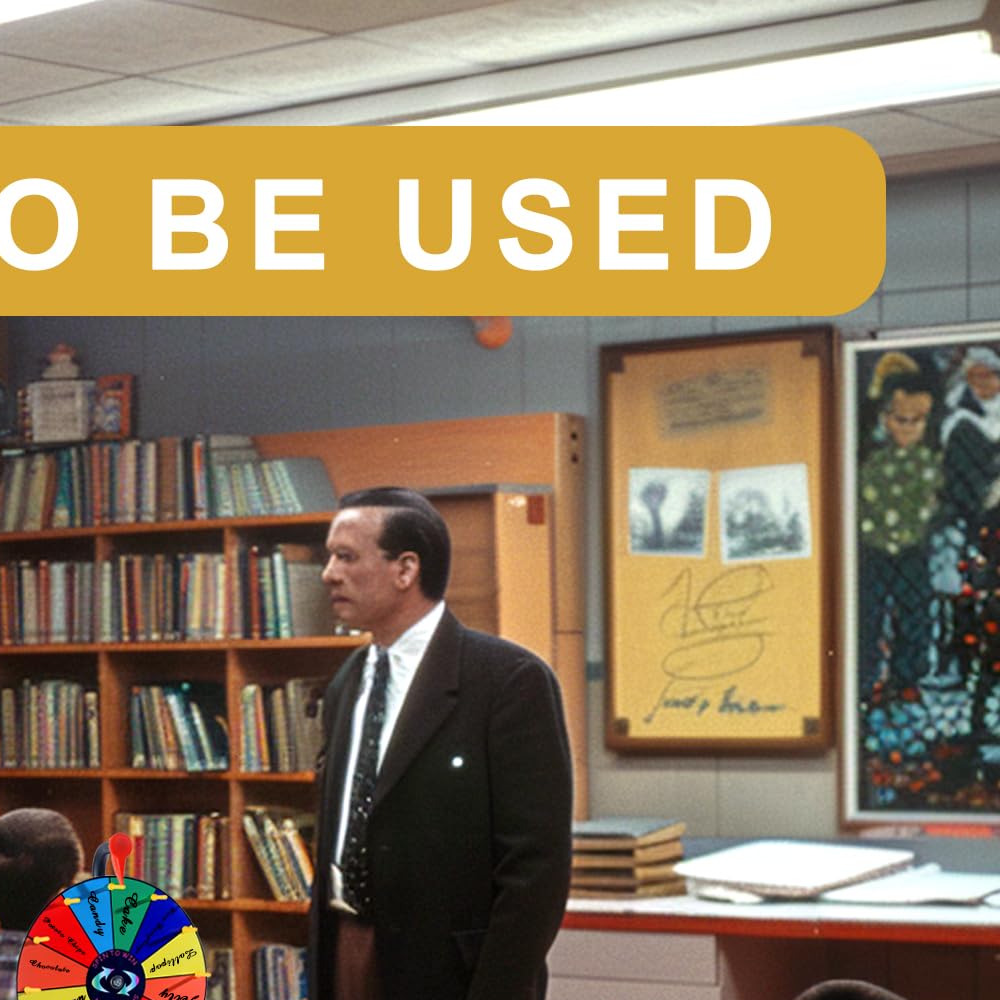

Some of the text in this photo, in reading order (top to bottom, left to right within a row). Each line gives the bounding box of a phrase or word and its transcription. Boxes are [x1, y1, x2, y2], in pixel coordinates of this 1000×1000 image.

[87, 890, 106, 937] Candy
[119, 892, 138, 936] Cake
[67, 936, 86, 955] Chips
[29, 959, 71, 974] Chocolate
[122, 951, 138, 966] WIN
[149, 948, 198, 974] Lollipop
